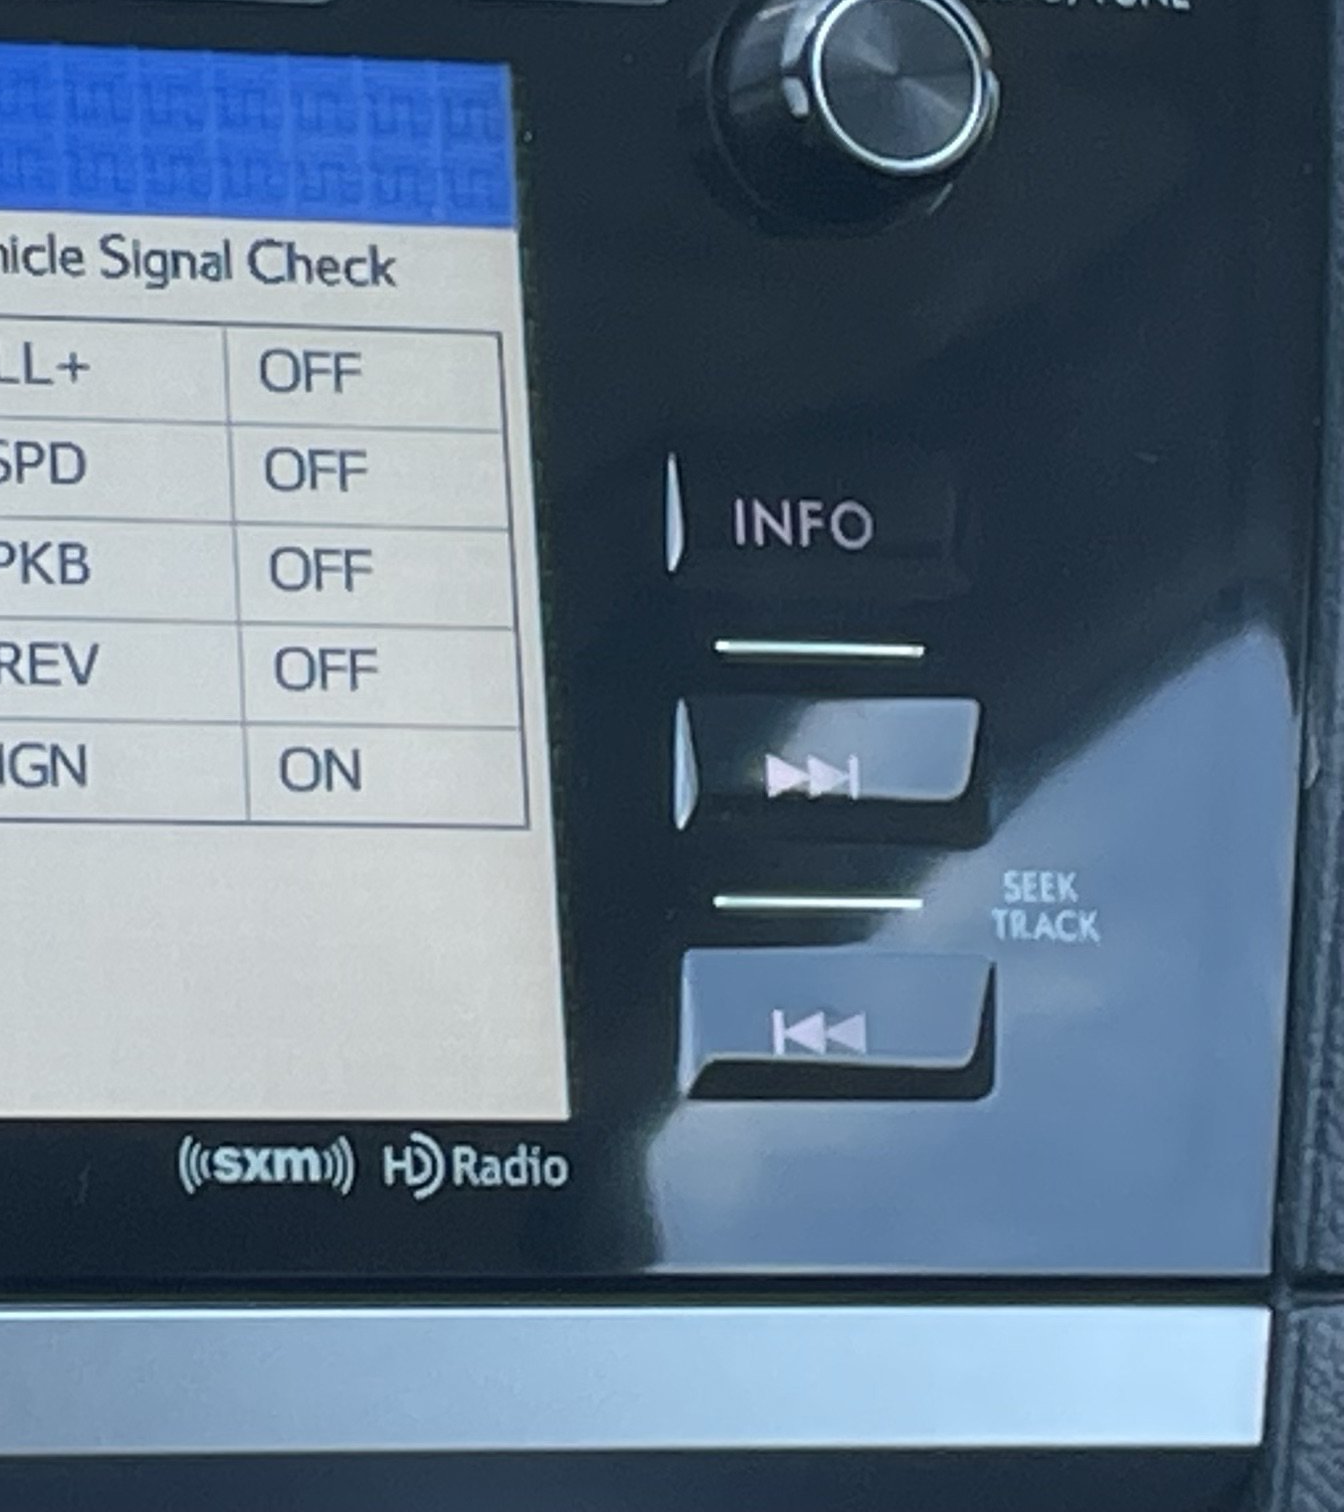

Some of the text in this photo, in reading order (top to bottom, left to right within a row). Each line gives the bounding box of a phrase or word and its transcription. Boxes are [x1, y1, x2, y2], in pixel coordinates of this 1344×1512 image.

[100, 236, 232, 290] Signal
[247, 240, 397, 288] Check
[258, 348, 363, 394] OFF
[264, 447, 369, 492] OFF
[734, 498, 874, 551] INFO
[268, 546, 373, 592] OFF
[273, 647, 379, 691] OFF
[277, 747, 363, 793] ON
[1004, 870, 1079, 904] SEEK
[991, 907, 1101, 943] TRACK
[452, 1143, 569, 1187] Radio
